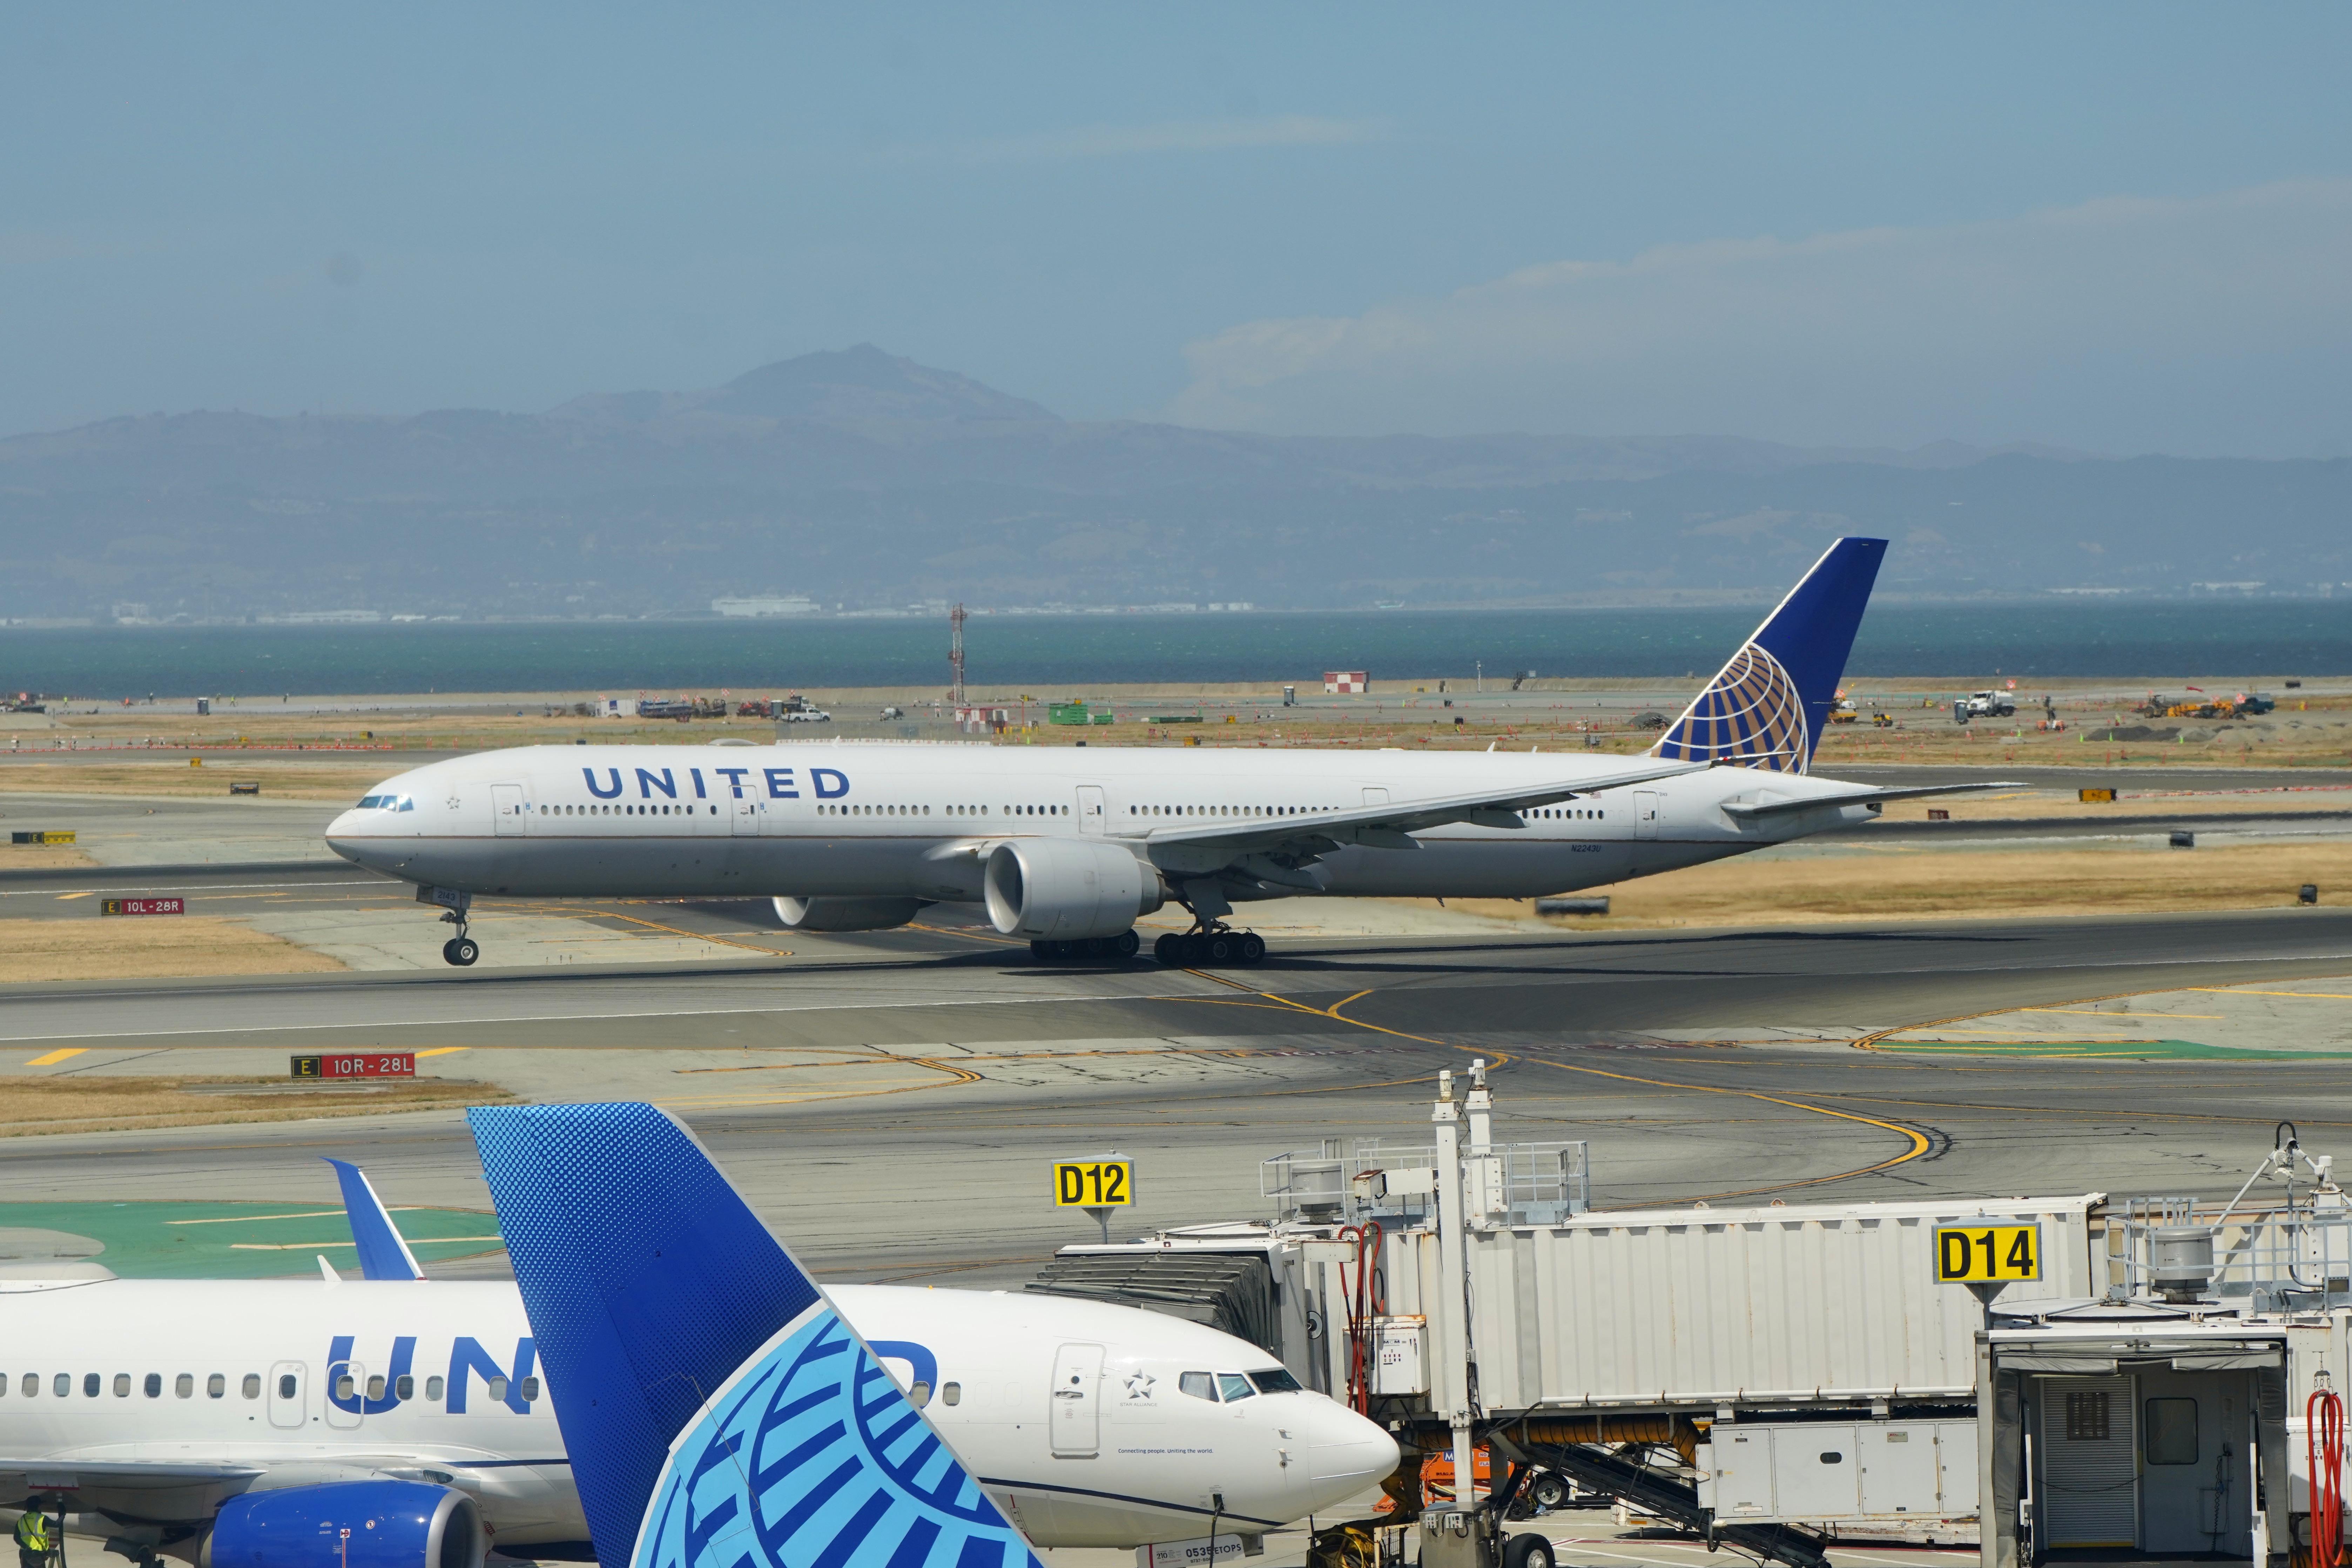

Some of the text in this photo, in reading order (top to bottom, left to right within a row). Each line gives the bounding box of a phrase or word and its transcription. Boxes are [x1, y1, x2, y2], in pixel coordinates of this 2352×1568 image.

[582, 768, 850, 799] UNITED
[1571, 844, 1602, 852] N2243U
[438, 891, 455, 901] 2143
[109, 902, 115, 912] E
[301, 1060, 311, 1074] E
[1060, 1164, 1125, 1204] D12
[1941, 1230, 2034, 1279] D14
[1215, 1544, 1241, 1554] ETOPS
